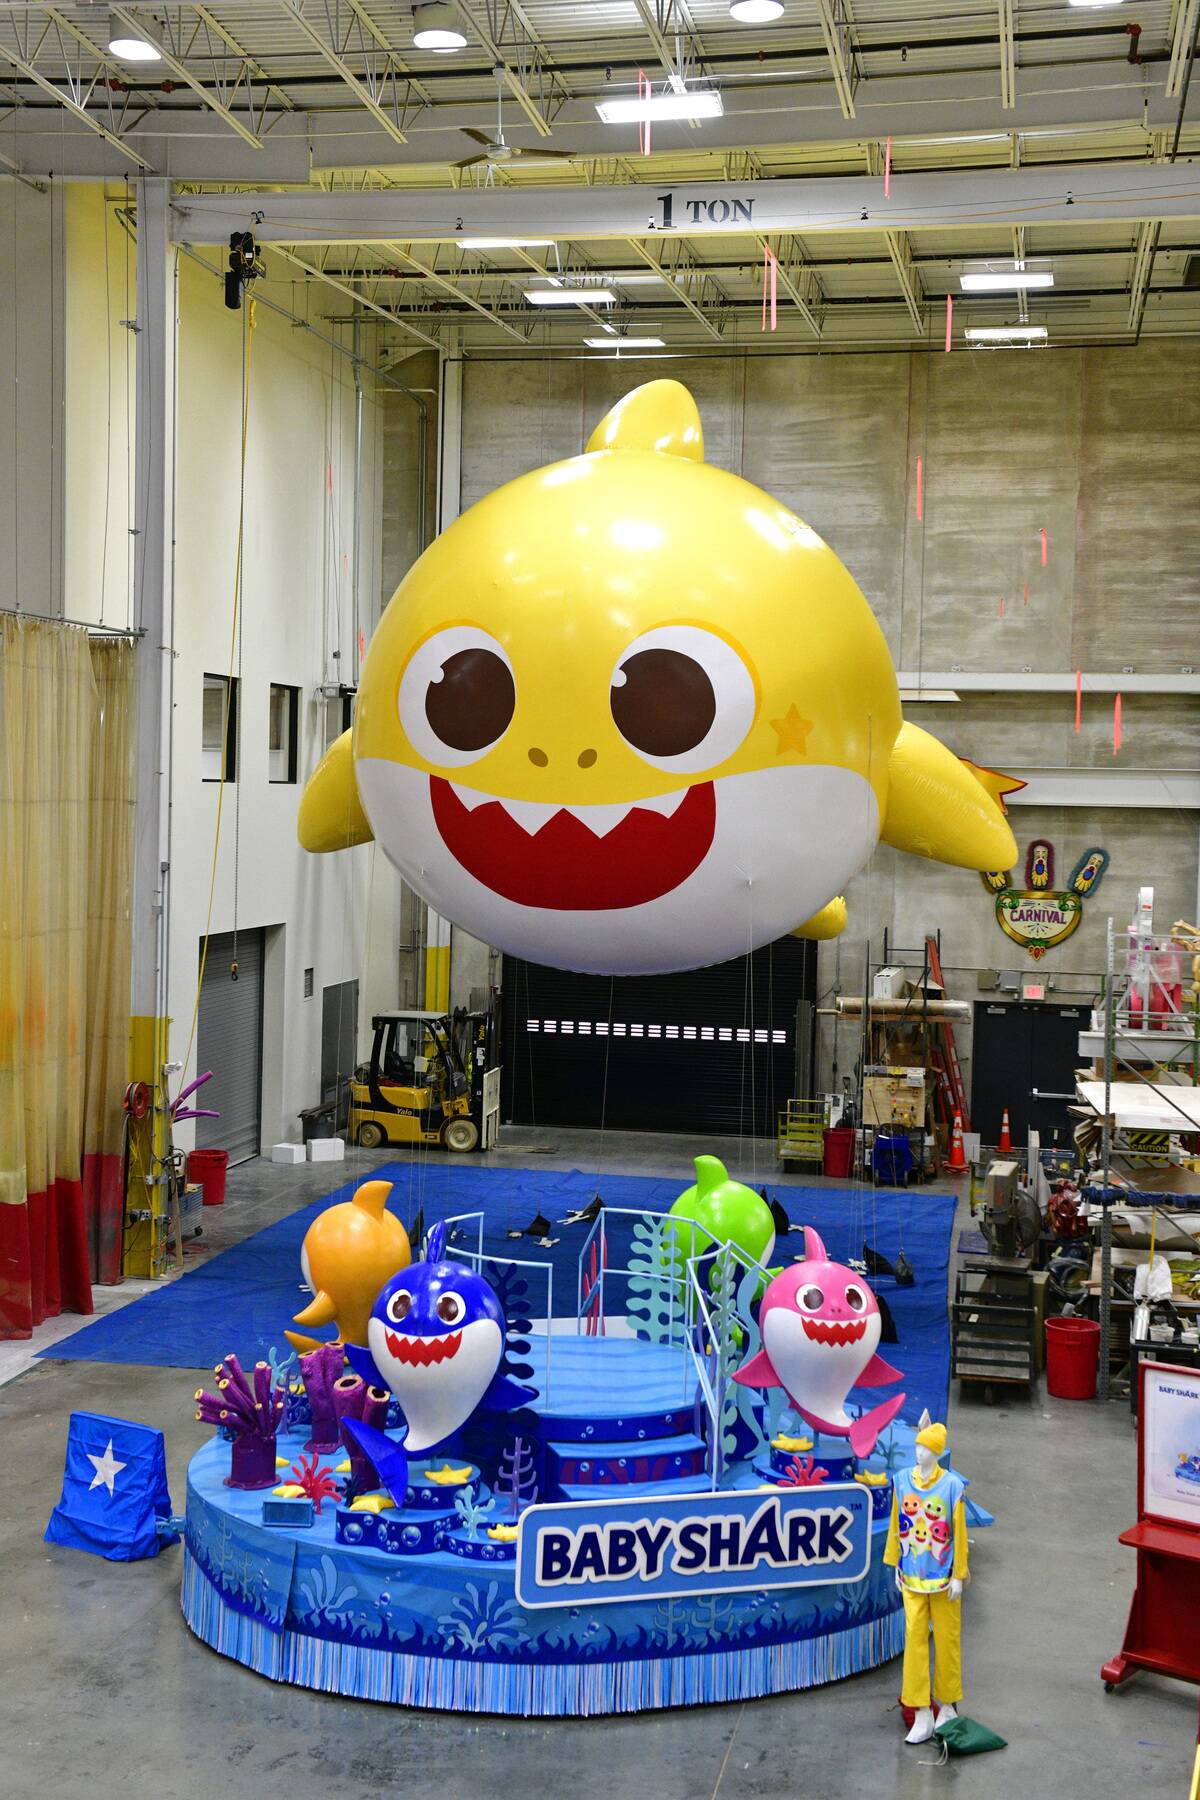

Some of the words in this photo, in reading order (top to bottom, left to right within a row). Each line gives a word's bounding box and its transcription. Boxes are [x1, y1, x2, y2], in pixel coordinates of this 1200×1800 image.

[657, 193, 677, 230] 1
[686, 198, 756, 223] TON
[1010, 908, 1067, 925] CARNIVAL
[1132, 1143, 1168, 1153] CAUTION
[1158, 1385, 1176, 1395] BABY
[1176, 1389, 1199, 1400] SHARK
[541, 1525, 672, 1581] BABY
[677, 1503, 849, 1569] SHARK
